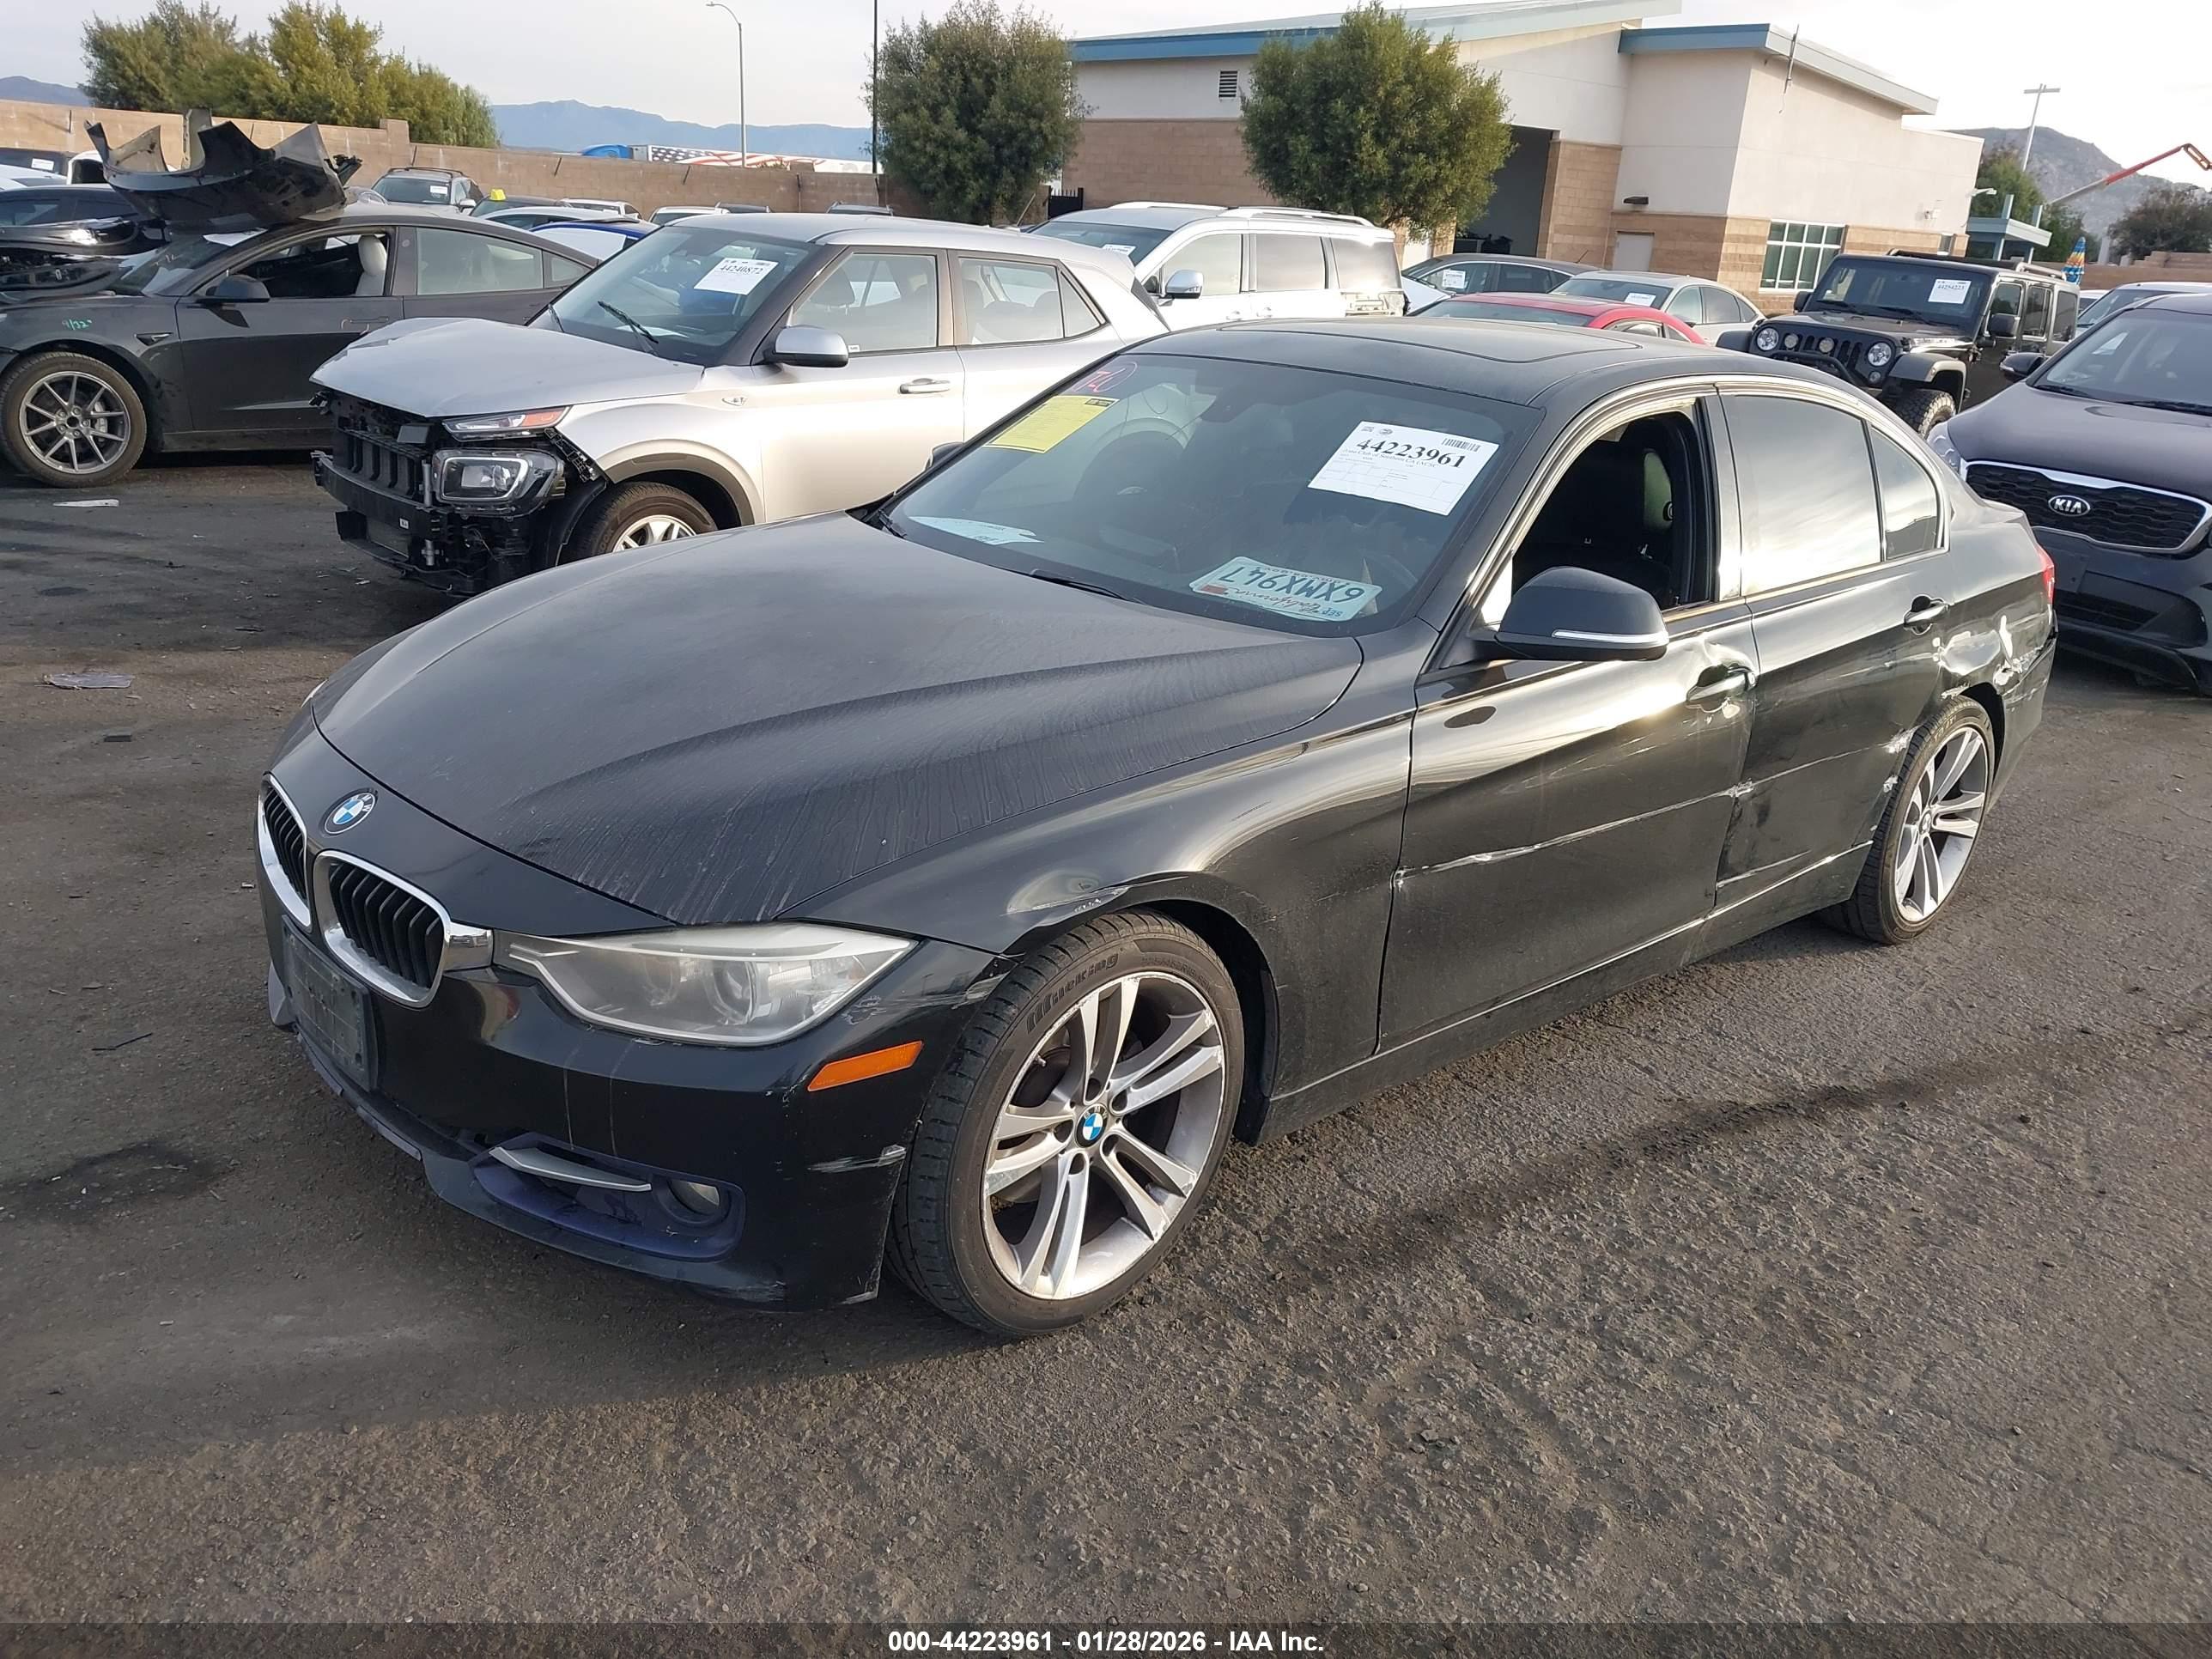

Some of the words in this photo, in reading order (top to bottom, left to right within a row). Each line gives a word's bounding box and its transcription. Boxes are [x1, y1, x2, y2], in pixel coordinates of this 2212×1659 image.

[1356, 437, 1466, 469] 44223961
[2054, 498, 2082, 514] KIA
[1218, 566, 1365, 604] 6XMX947
[1321, 607, 1344, 617] SEP
